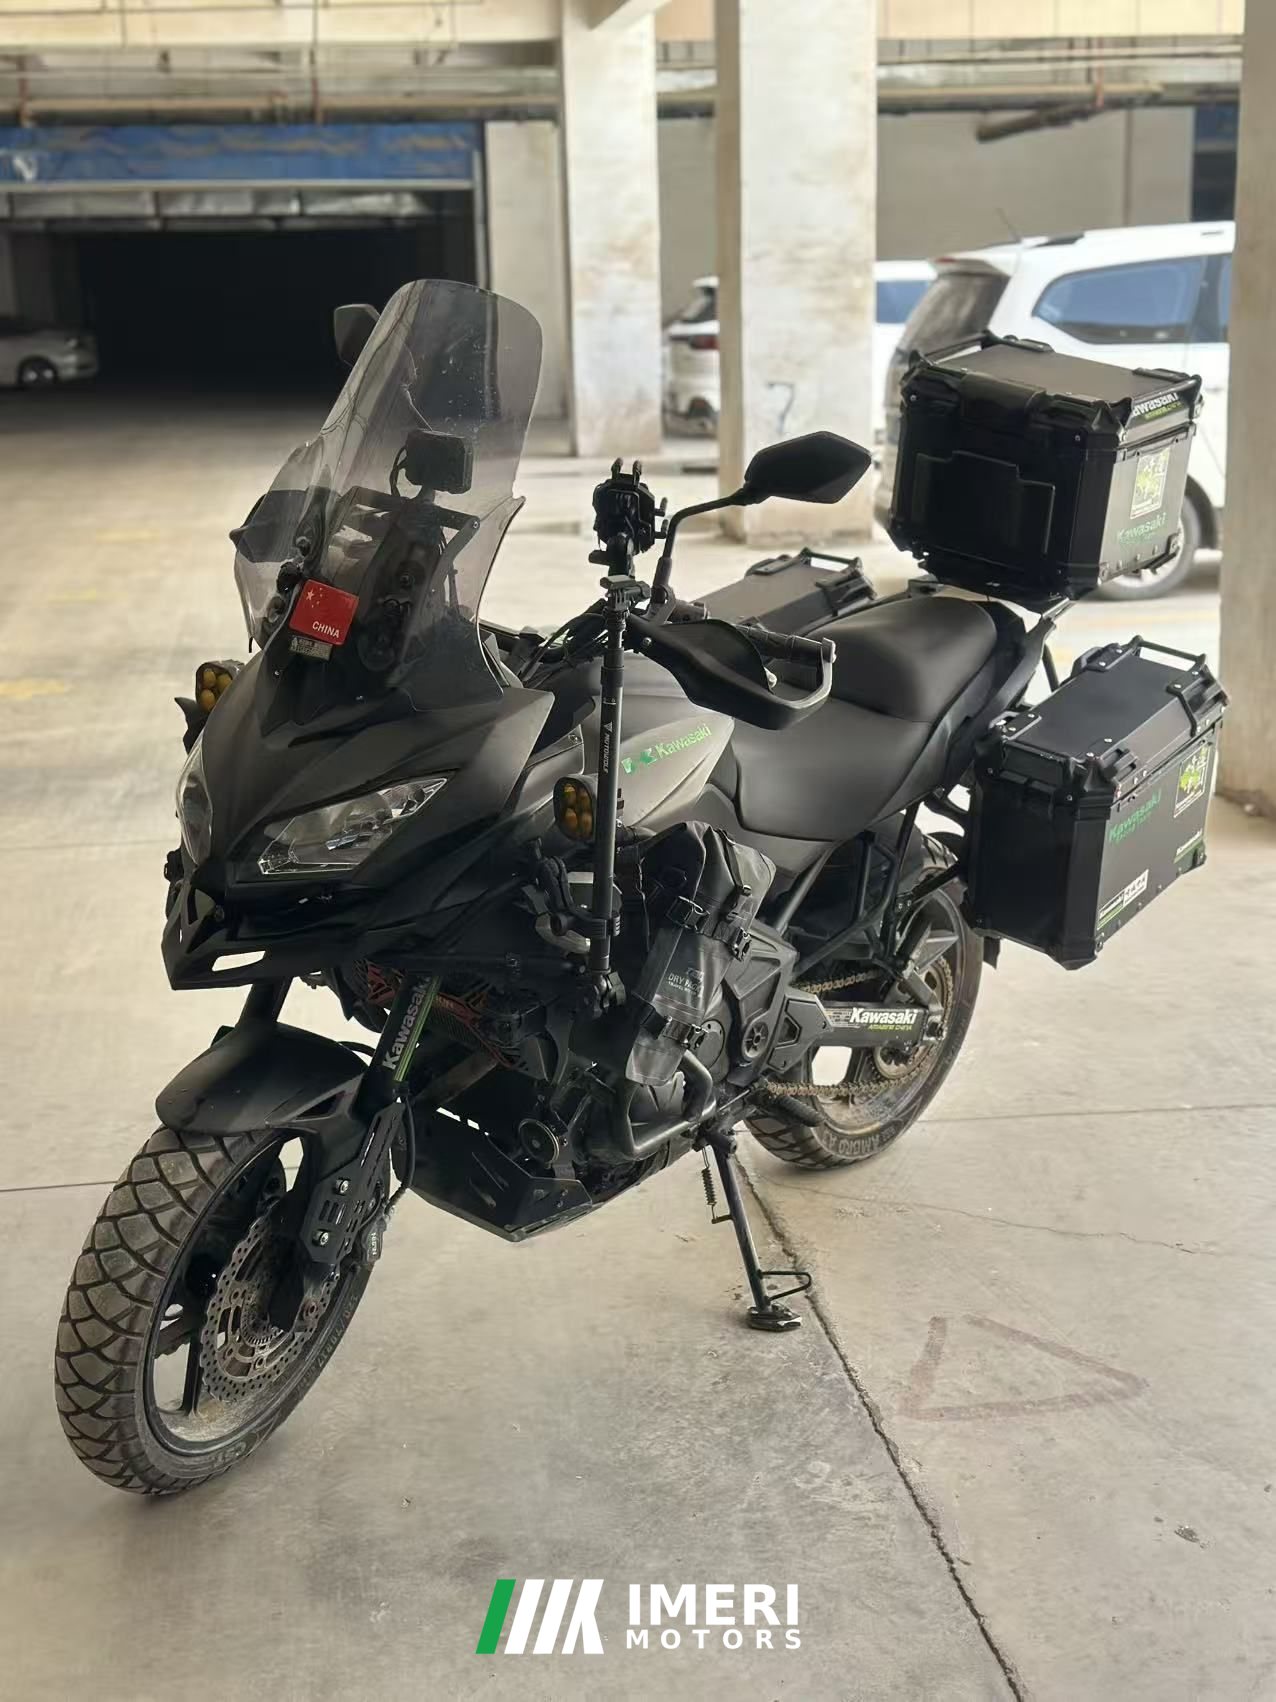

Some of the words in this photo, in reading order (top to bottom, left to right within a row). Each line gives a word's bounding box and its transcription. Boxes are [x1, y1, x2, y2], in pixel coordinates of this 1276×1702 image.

[312, 621, 340, 638] CHINA
[655, 724, 712, 758] Kawasaki
[668, 972, 685, 985] DRY
[382, 977, 431, 1070] Kawasaki
[849, 1007, 918, 1024] Kawasaki
